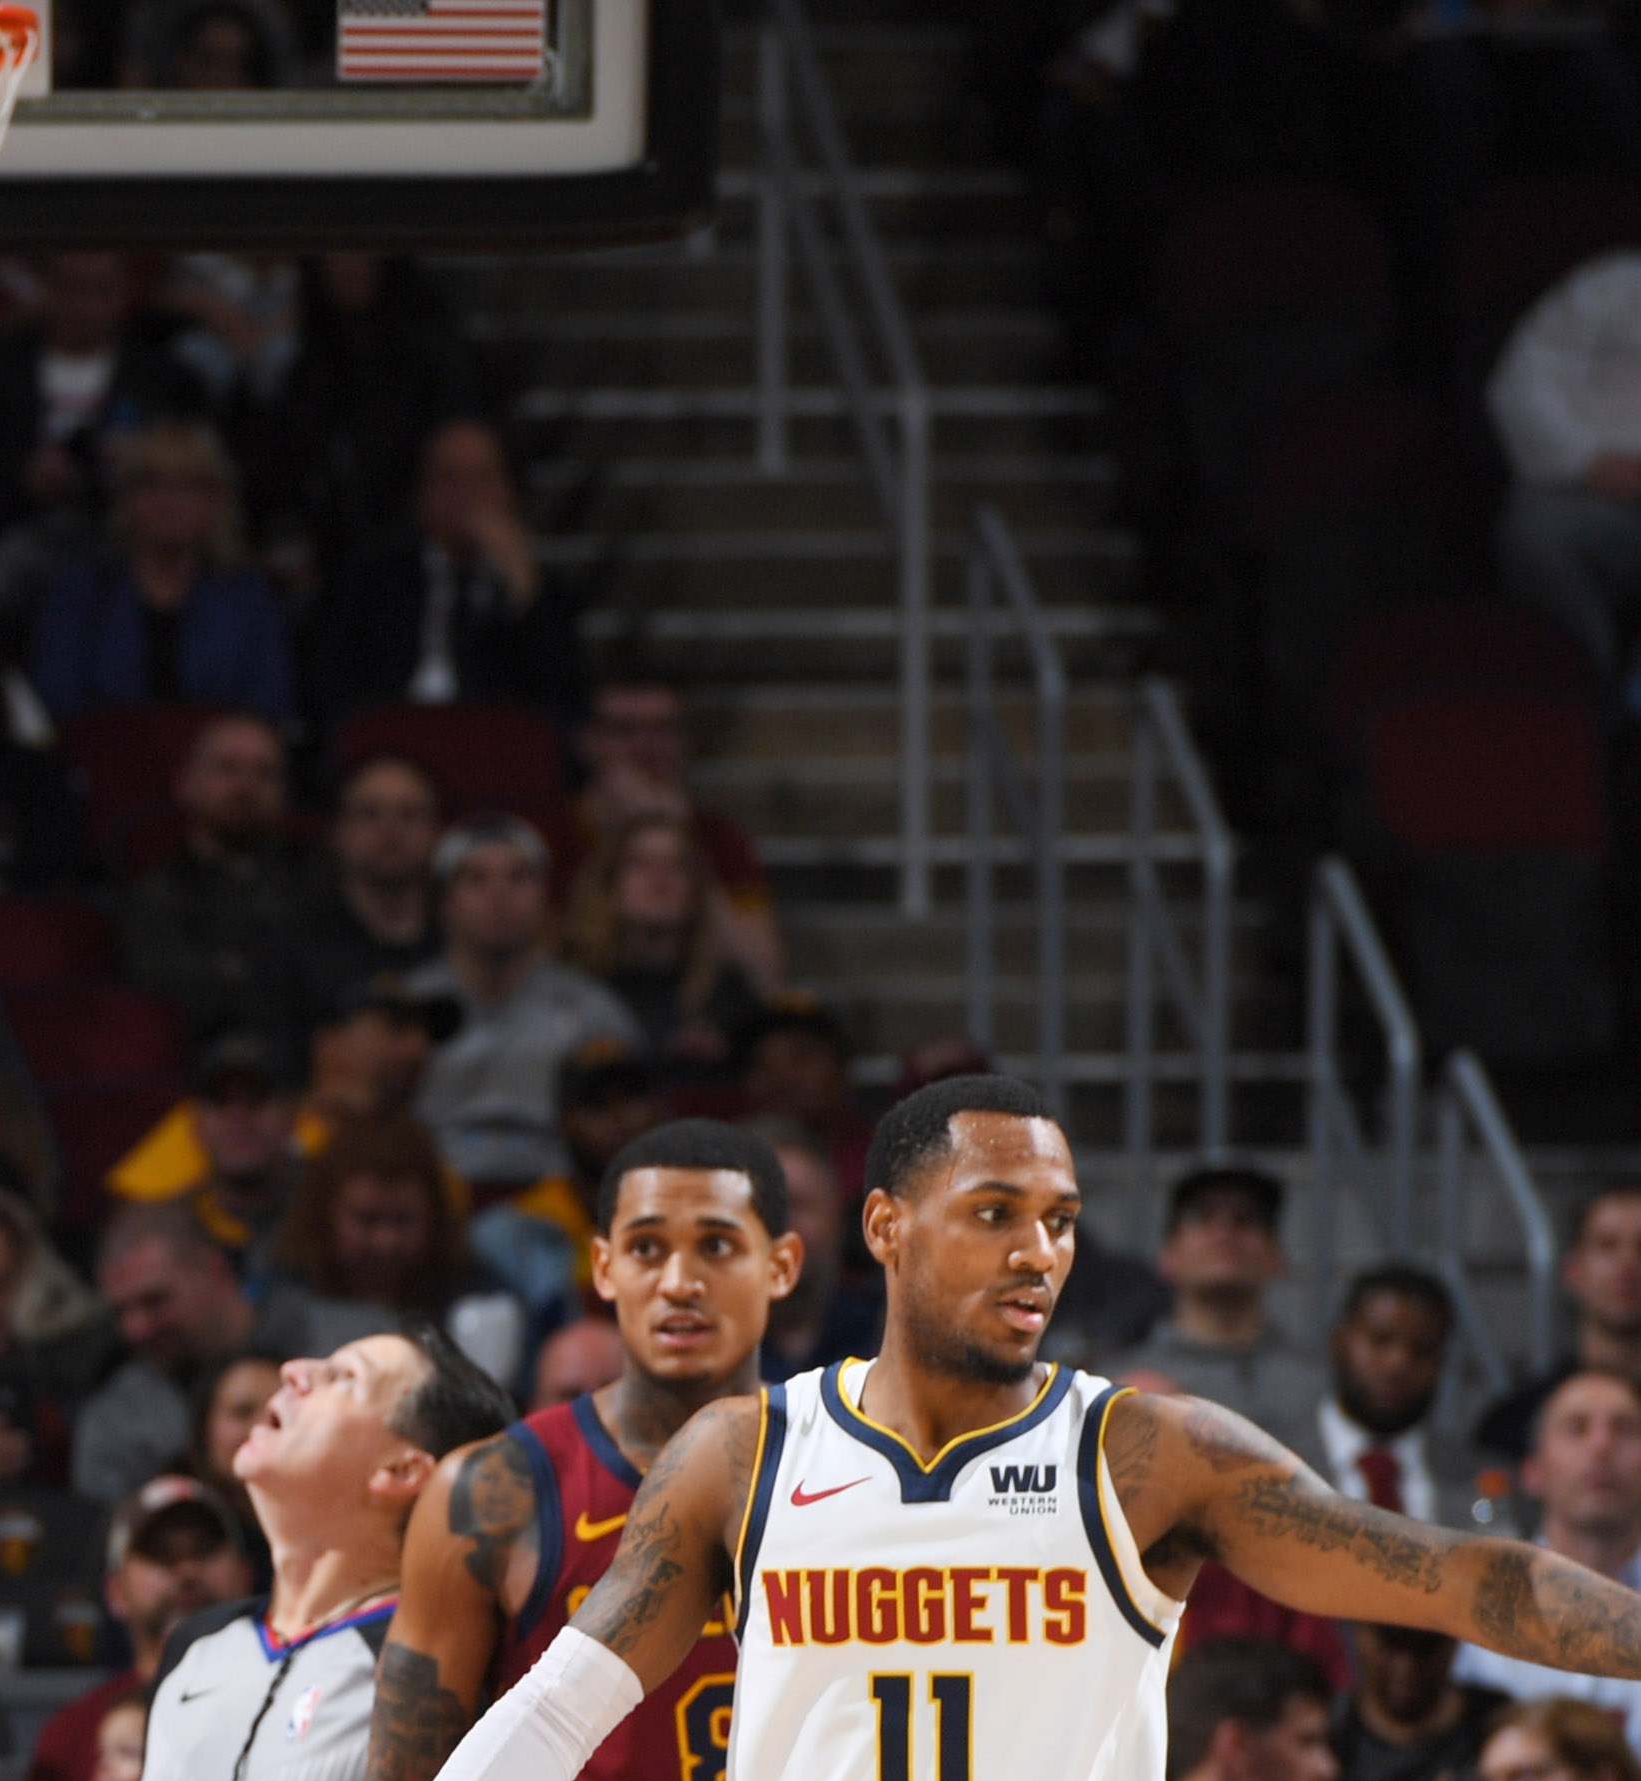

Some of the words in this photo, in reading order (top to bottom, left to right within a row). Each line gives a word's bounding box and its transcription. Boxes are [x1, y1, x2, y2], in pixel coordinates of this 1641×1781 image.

[990, 1465, 1057, 1493] WU
[988, 1497, 1057, 1506] WESTERN
[1009, 1506, 1057, 1516] UNION
[761, 1566, 1088, 1647] NUGGETS
